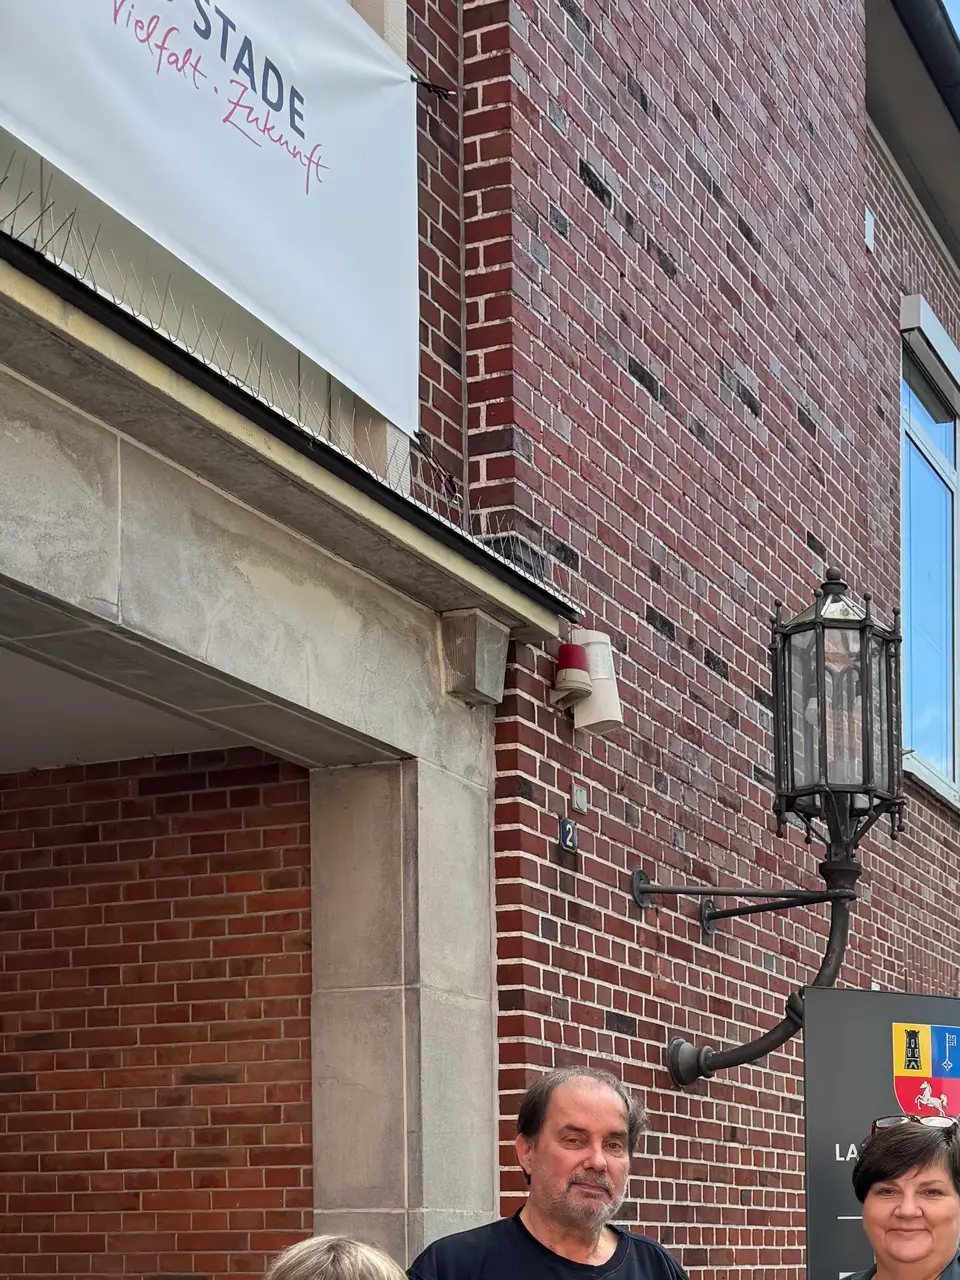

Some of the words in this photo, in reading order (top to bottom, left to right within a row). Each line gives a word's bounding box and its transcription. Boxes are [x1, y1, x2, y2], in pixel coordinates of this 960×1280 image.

[193, 0, 305, 140] STADE
[222, 79, 330, 195] Zukunft
[566, 824, 573, 847] 2
